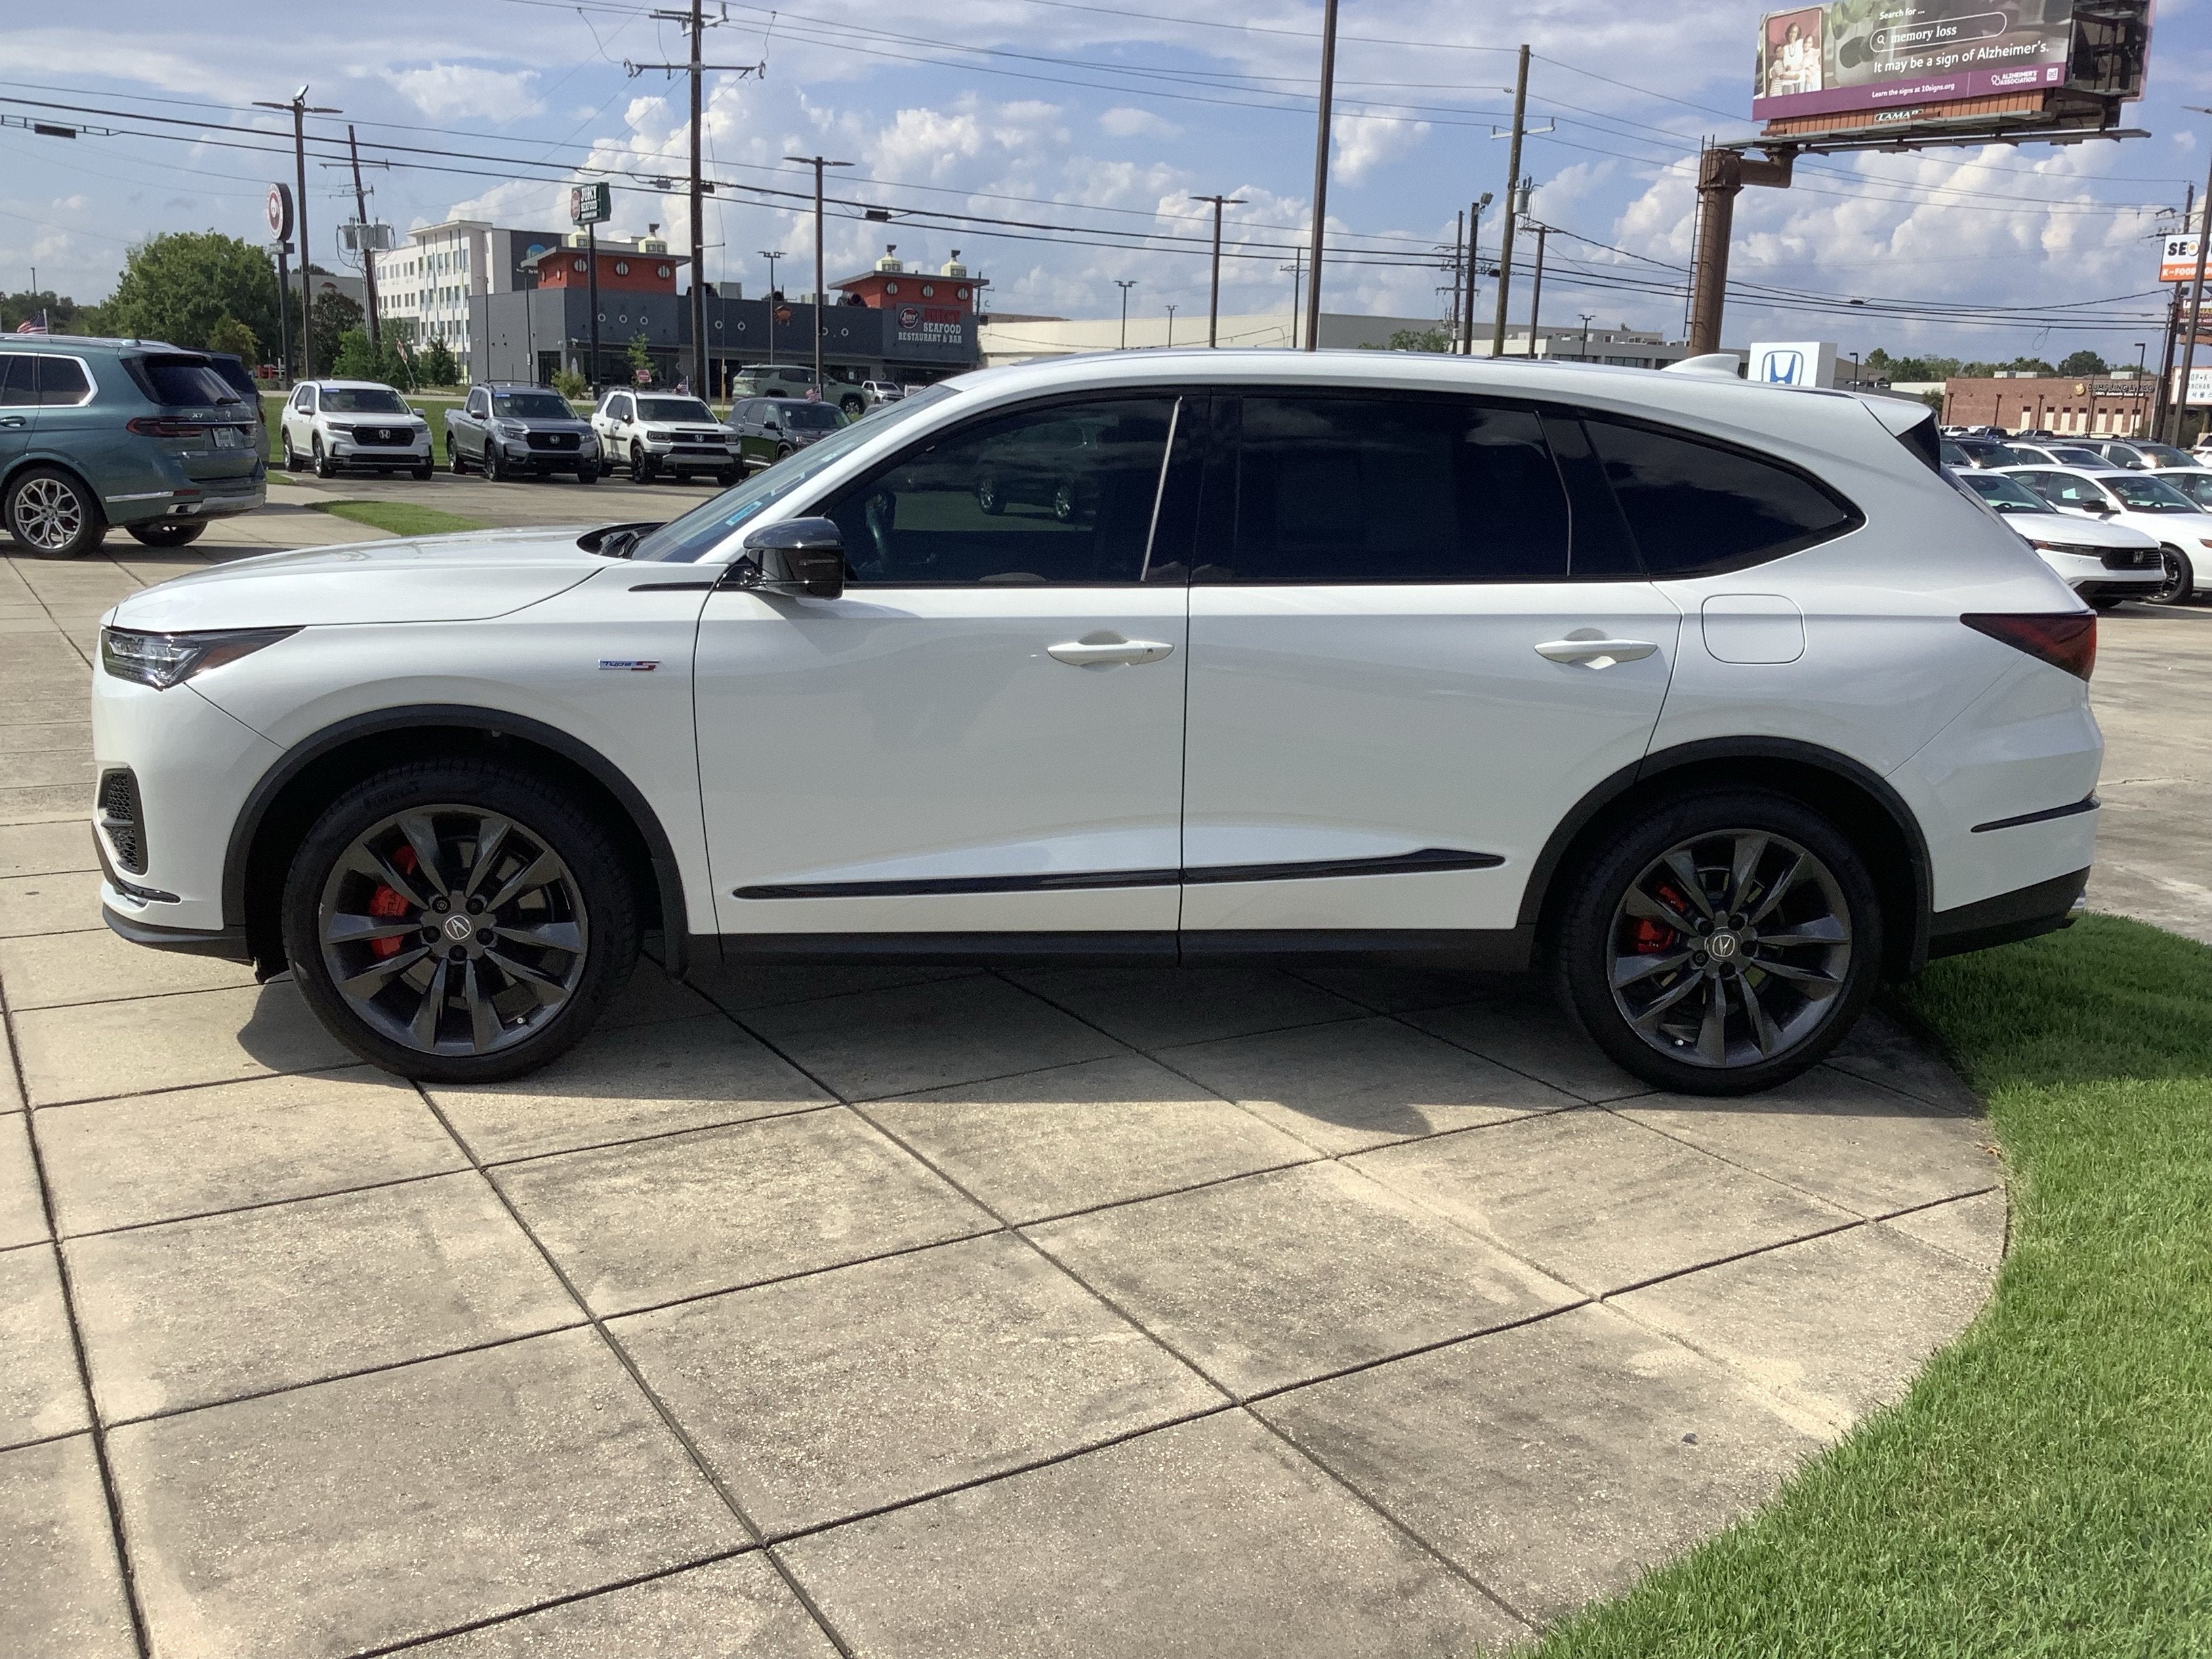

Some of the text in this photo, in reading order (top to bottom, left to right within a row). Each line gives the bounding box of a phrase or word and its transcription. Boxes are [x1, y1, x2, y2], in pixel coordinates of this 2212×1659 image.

[1879, 9, 1904, 20] Search
[1905, 7, 1917, 17] for
[1890, 26, 1957, 44] memory loss
[1874, 41, 2049, 73] It may be a sign of Alzheimer's.
[2000, 77, 2037, 85] ASSOCIATION
[1899, 87, 1914, 96] signs
[1922, 83, 1955, 93] 10signs.org
[581, 186, 597, 202] JUICY
[923, 323, 962, 334] SEAFOOD
[898, 331, 962, 344] RESTAURANT & BAR
[2088, 384, 2127, 392] DUMPLING
